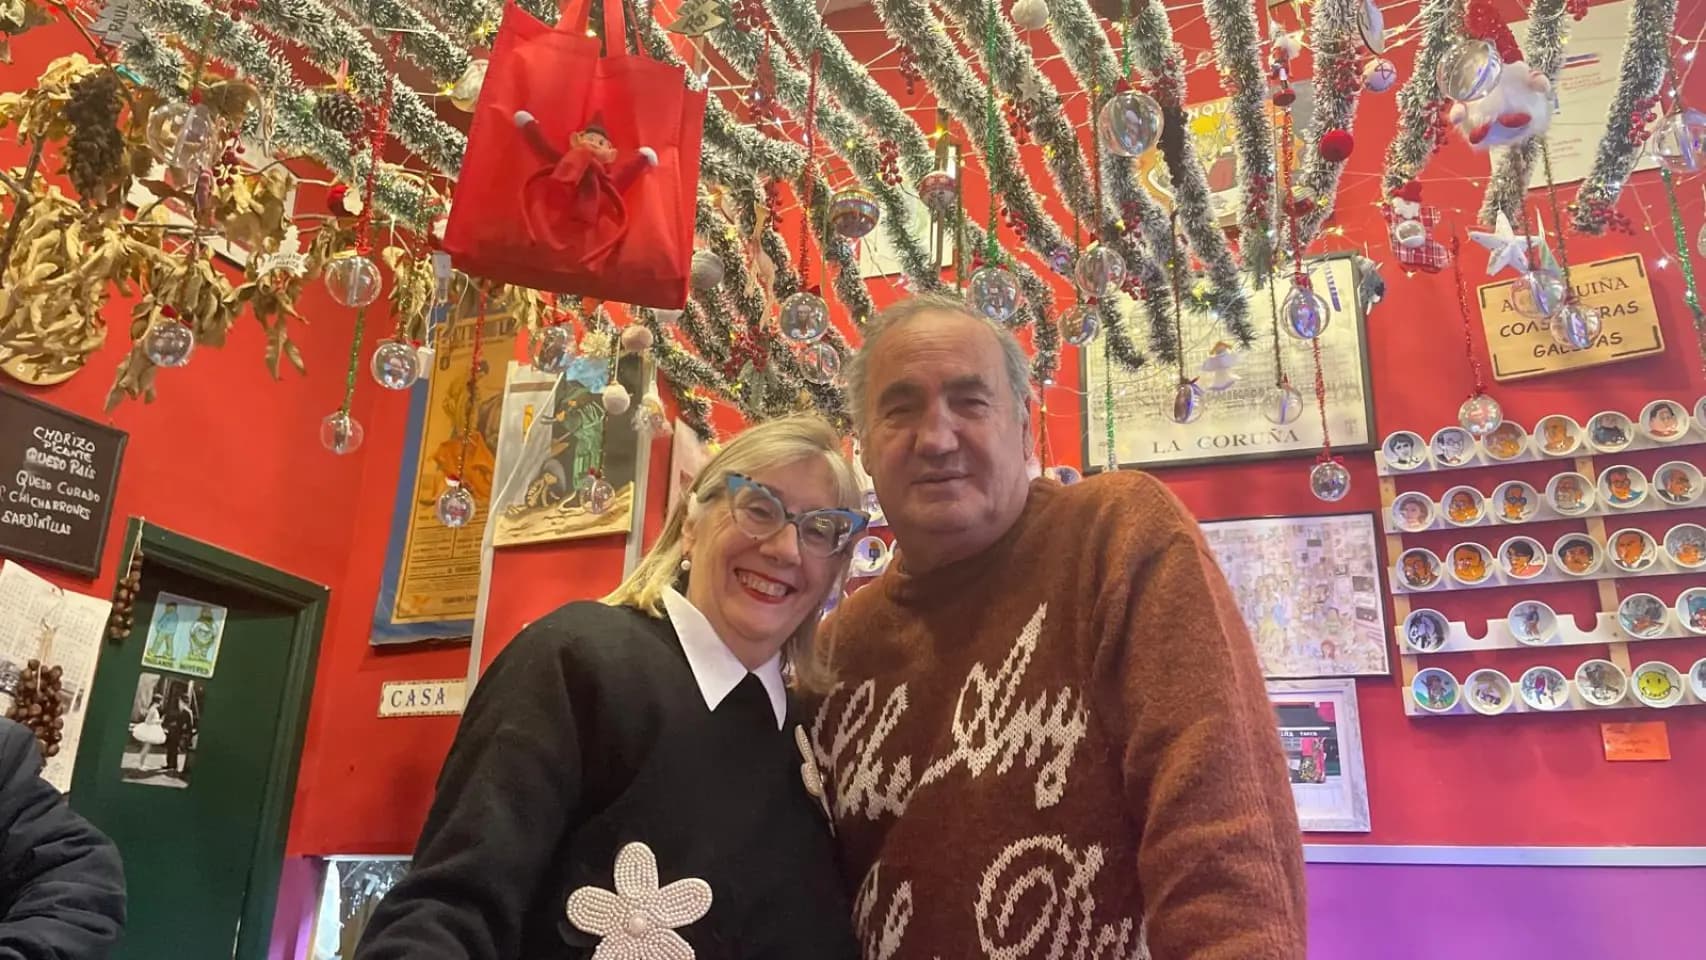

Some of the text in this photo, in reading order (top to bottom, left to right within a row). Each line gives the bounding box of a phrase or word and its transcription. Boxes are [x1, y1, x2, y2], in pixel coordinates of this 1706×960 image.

[1533, 332, 1623, 358] GALAS
[33, 426, 96, 453] CHORIZO
[43, 439, 92, 463] PICANTE
[1153, 428, 1300, 454] LA CORUÑA
[26, 447, 67, 471] QUESO
[16, 470, 52, 491] QUESO
[57, 481, 101, 502] CURADO
[8, 490, 92, 521] CHICHARRONES
[1, 510, 72, 535] SARDINILLAS
[391, 687, 445, 708] CASA
